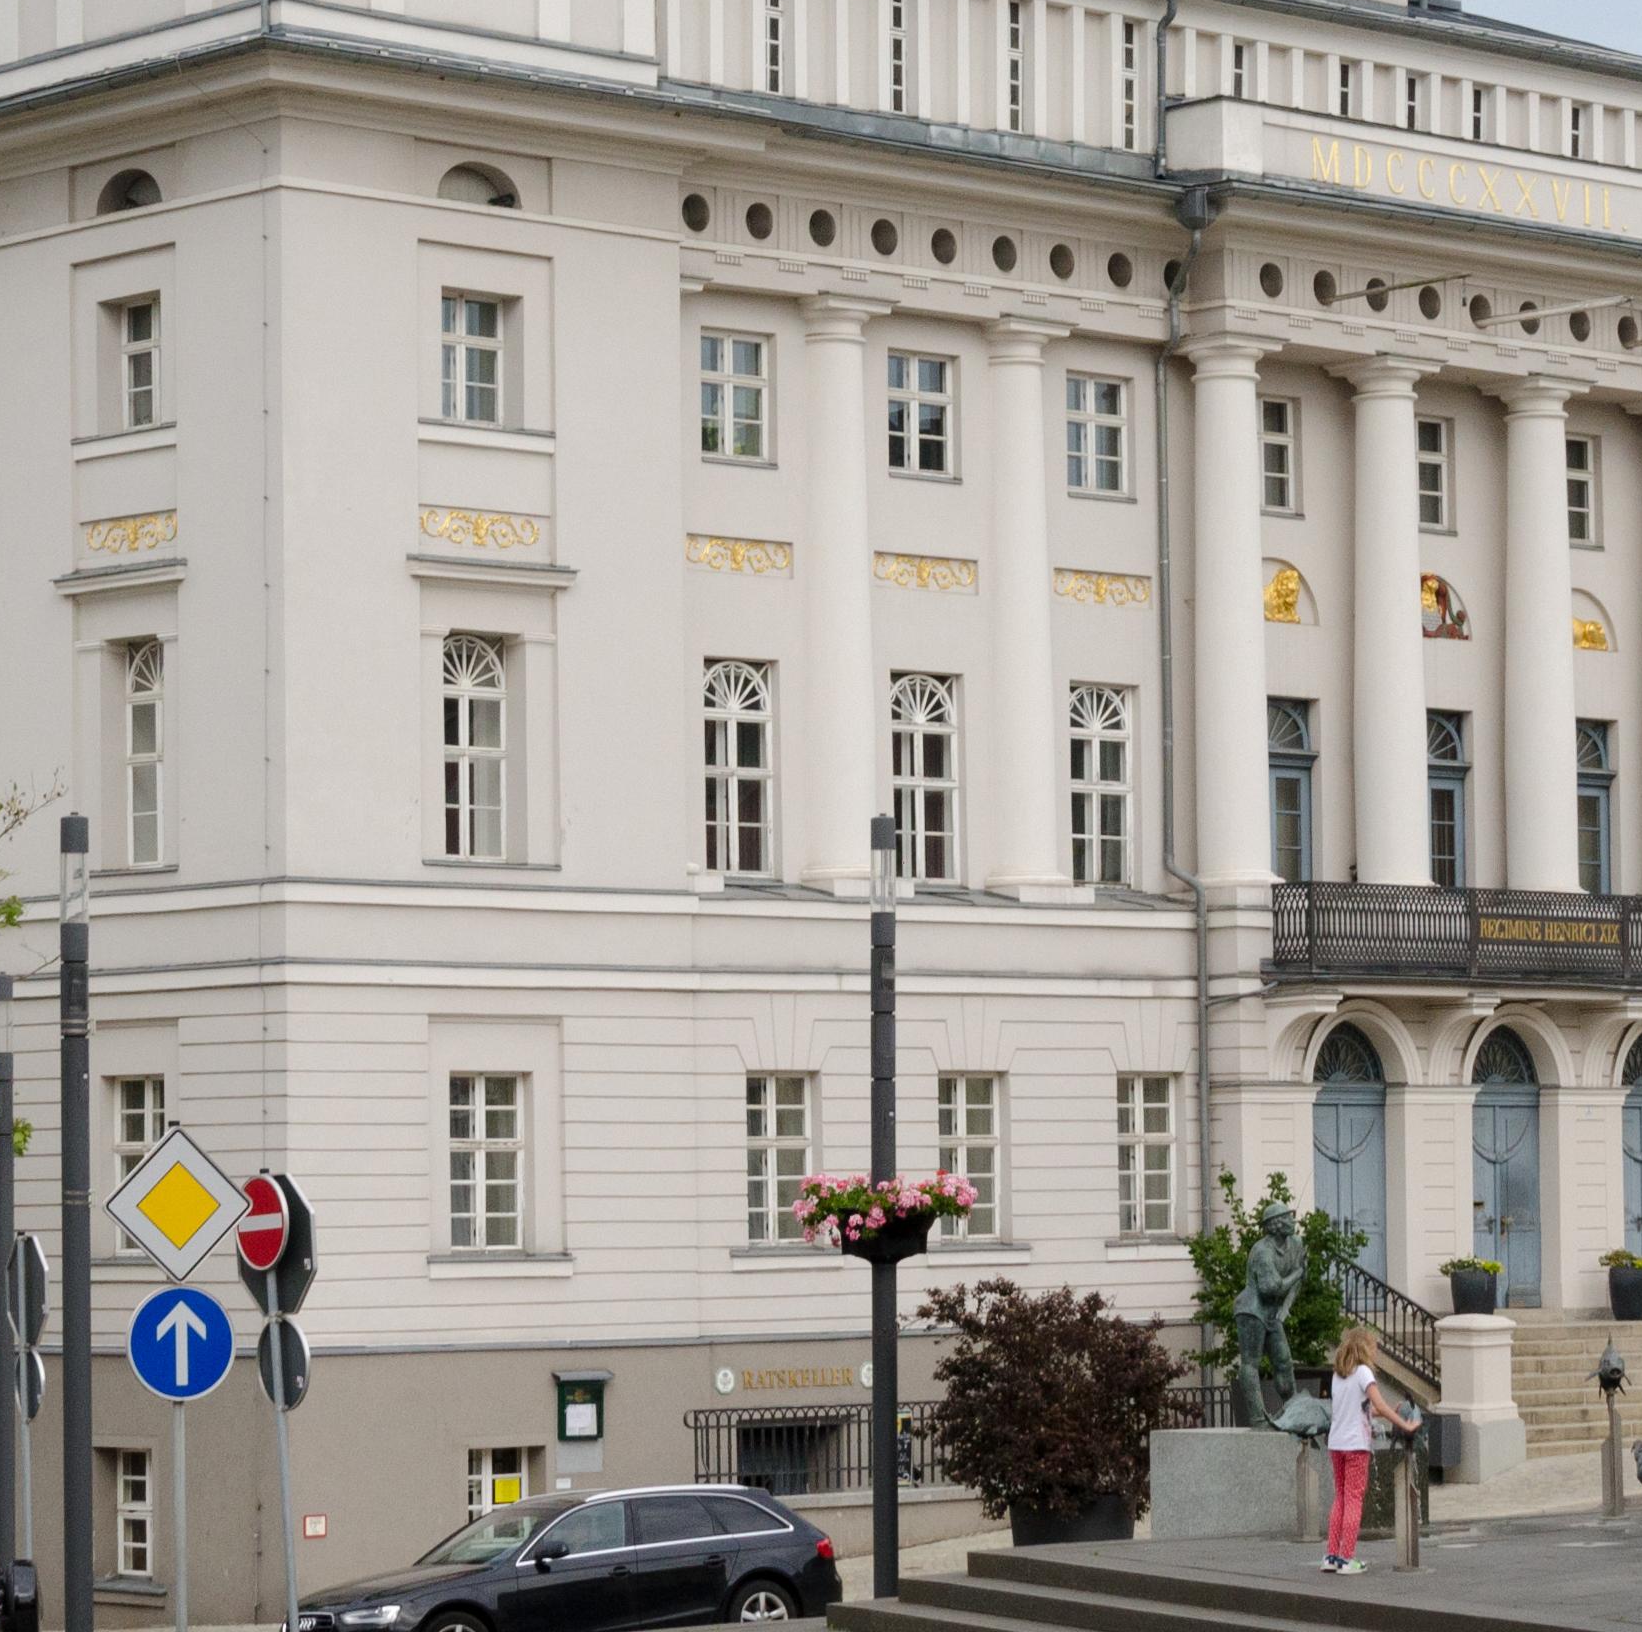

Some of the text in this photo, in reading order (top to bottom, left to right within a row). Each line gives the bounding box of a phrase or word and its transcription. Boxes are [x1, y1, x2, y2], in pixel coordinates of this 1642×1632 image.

[1544, 921, 1596, 944] HENRICI
[1600, 924, 1622, 945] XIX
[742, 1367, 854, 1389] RATSKELLER
